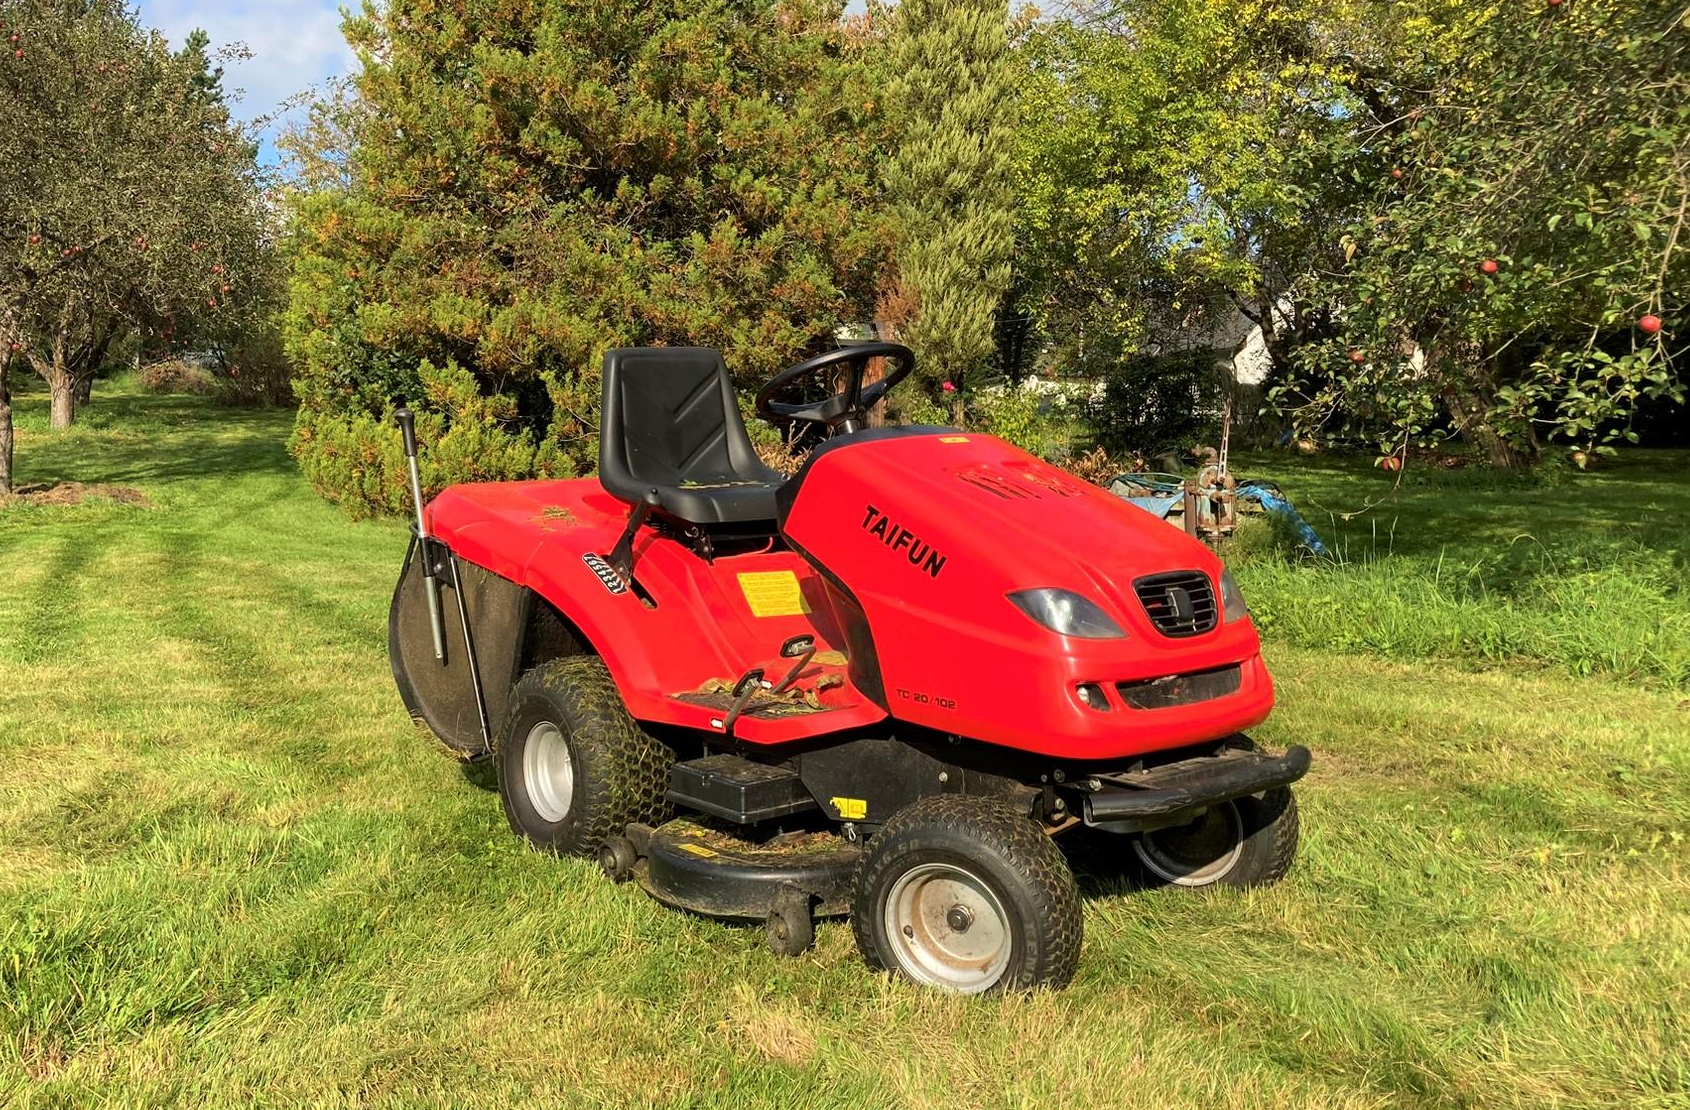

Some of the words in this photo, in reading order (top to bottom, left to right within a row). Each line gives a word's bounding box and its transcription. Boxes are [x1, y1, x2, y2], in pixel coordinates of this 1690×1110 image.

[861, 504, 947, 579] TAIFUN
[896, 688, 910, 699] TC
[913, 692, 956, 710] 20/102
